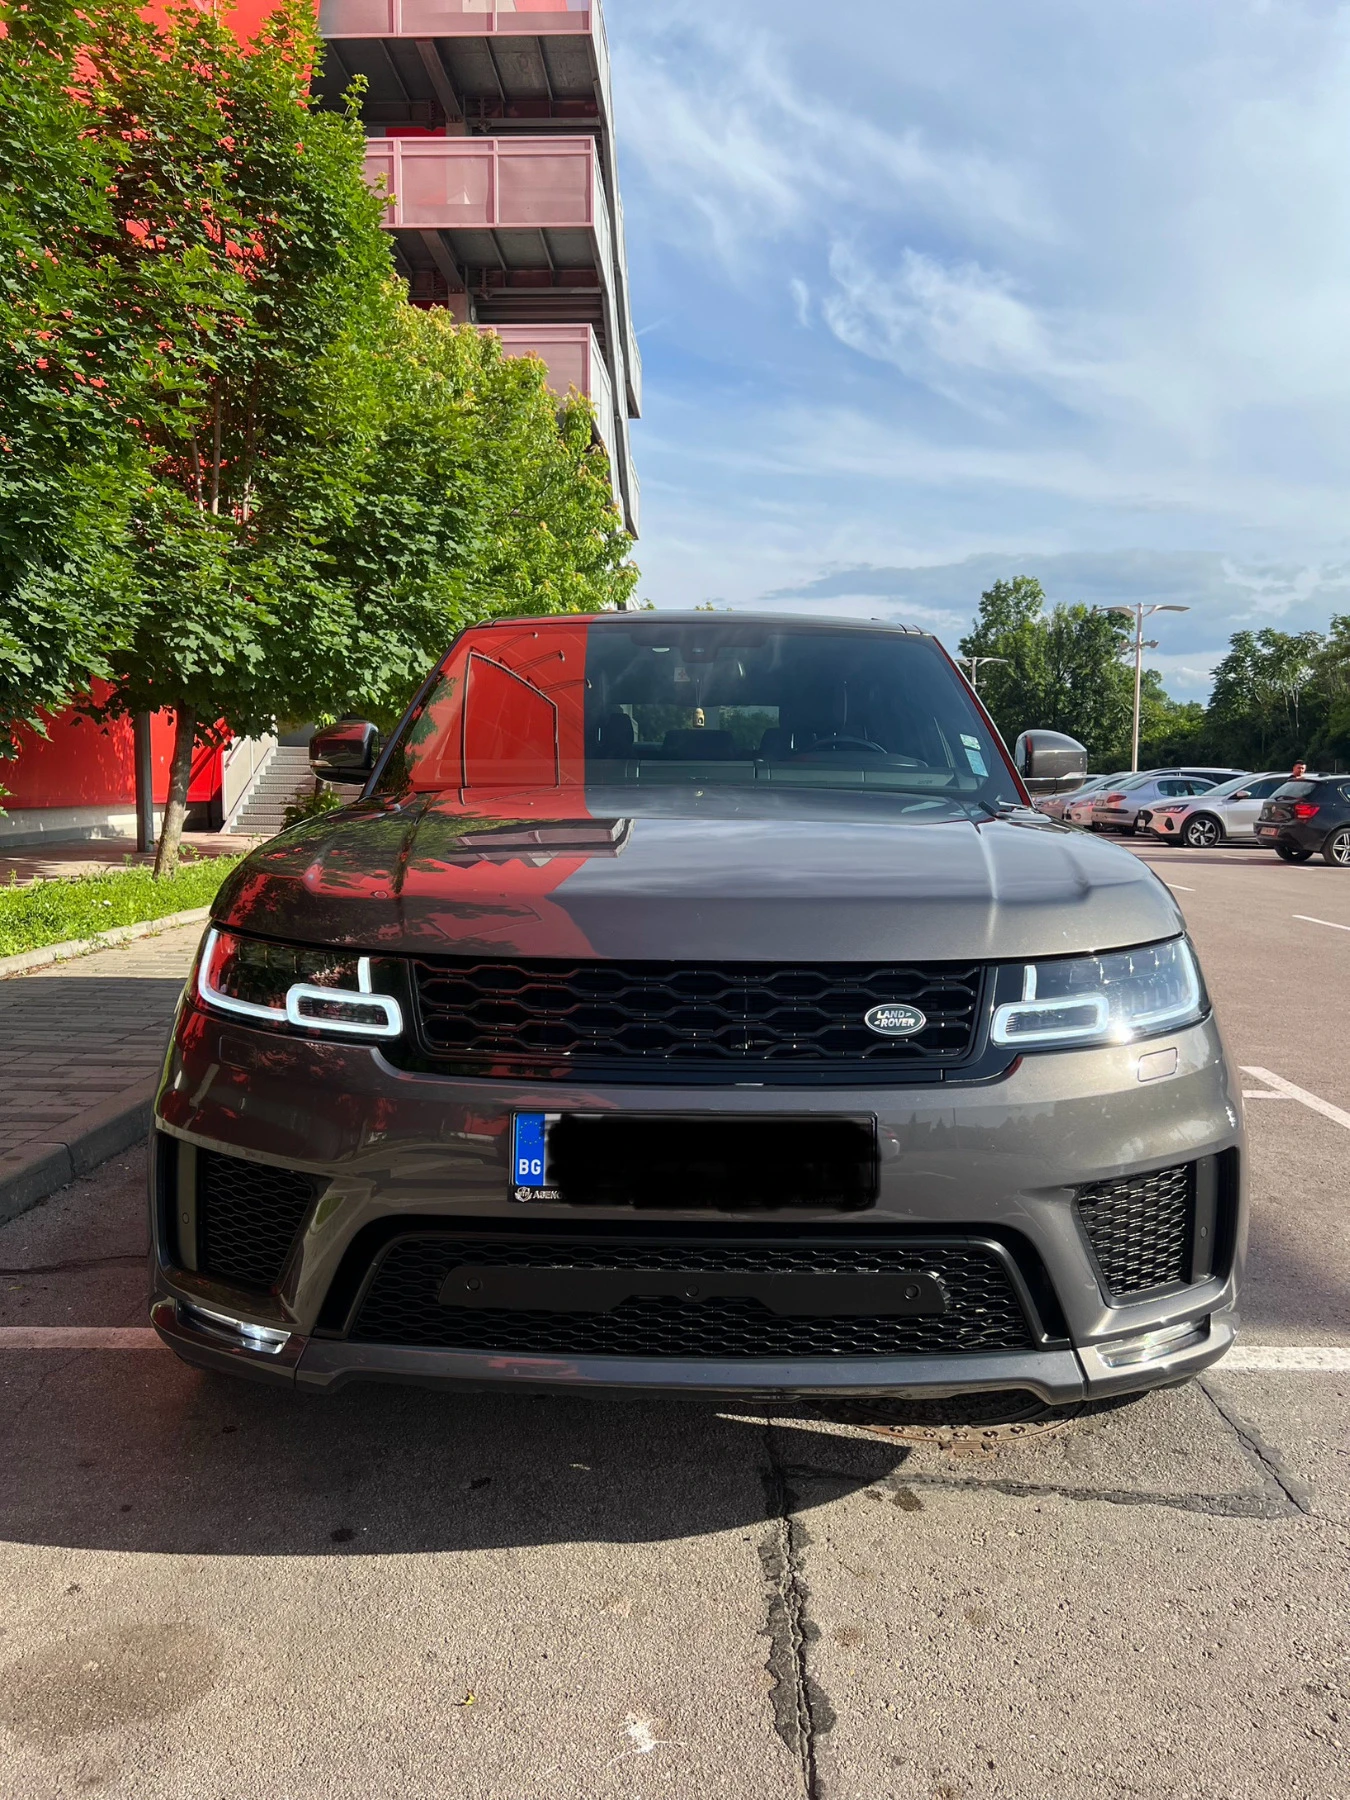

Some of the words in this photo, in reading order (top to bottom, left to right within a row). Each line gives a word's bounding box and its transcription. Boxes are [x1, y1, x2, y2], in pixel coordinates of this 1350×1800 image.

[876, 1010, 905, 1019] LAND
[880, 1018, 916, 1027] ROVER
[519, 1159, 541, 1175] BG
